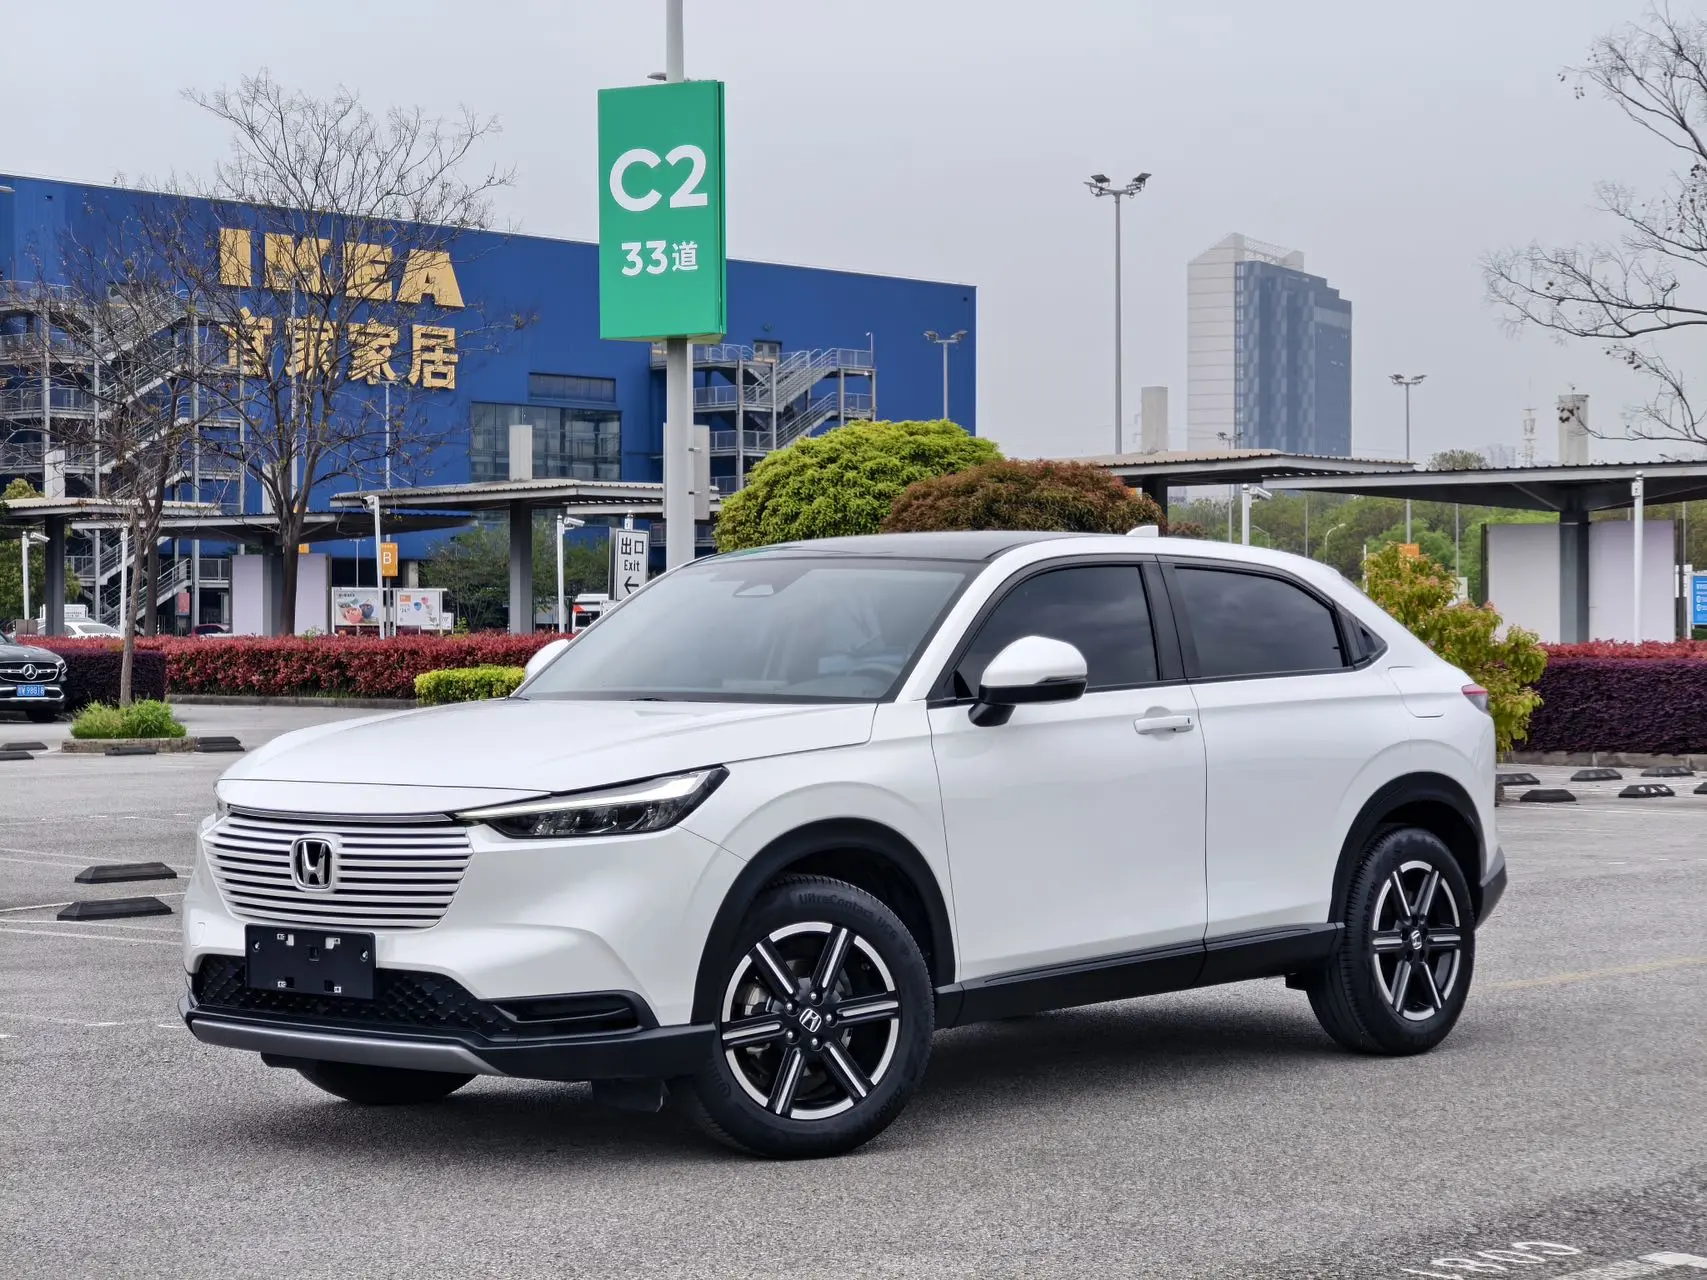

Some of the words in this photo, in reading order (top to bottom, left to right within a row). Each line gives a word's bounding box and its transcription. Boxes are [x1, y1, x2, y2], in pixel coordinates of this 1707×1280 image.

[609, 144, 708, 212] C2
[219, 227, 465, 308] IKEA
[621, 240, 698, 276] 33道
[383, 551, 392, 565] B
[620, 537, 644, 556] 出口
[624, 559, 640, 572] Exit
